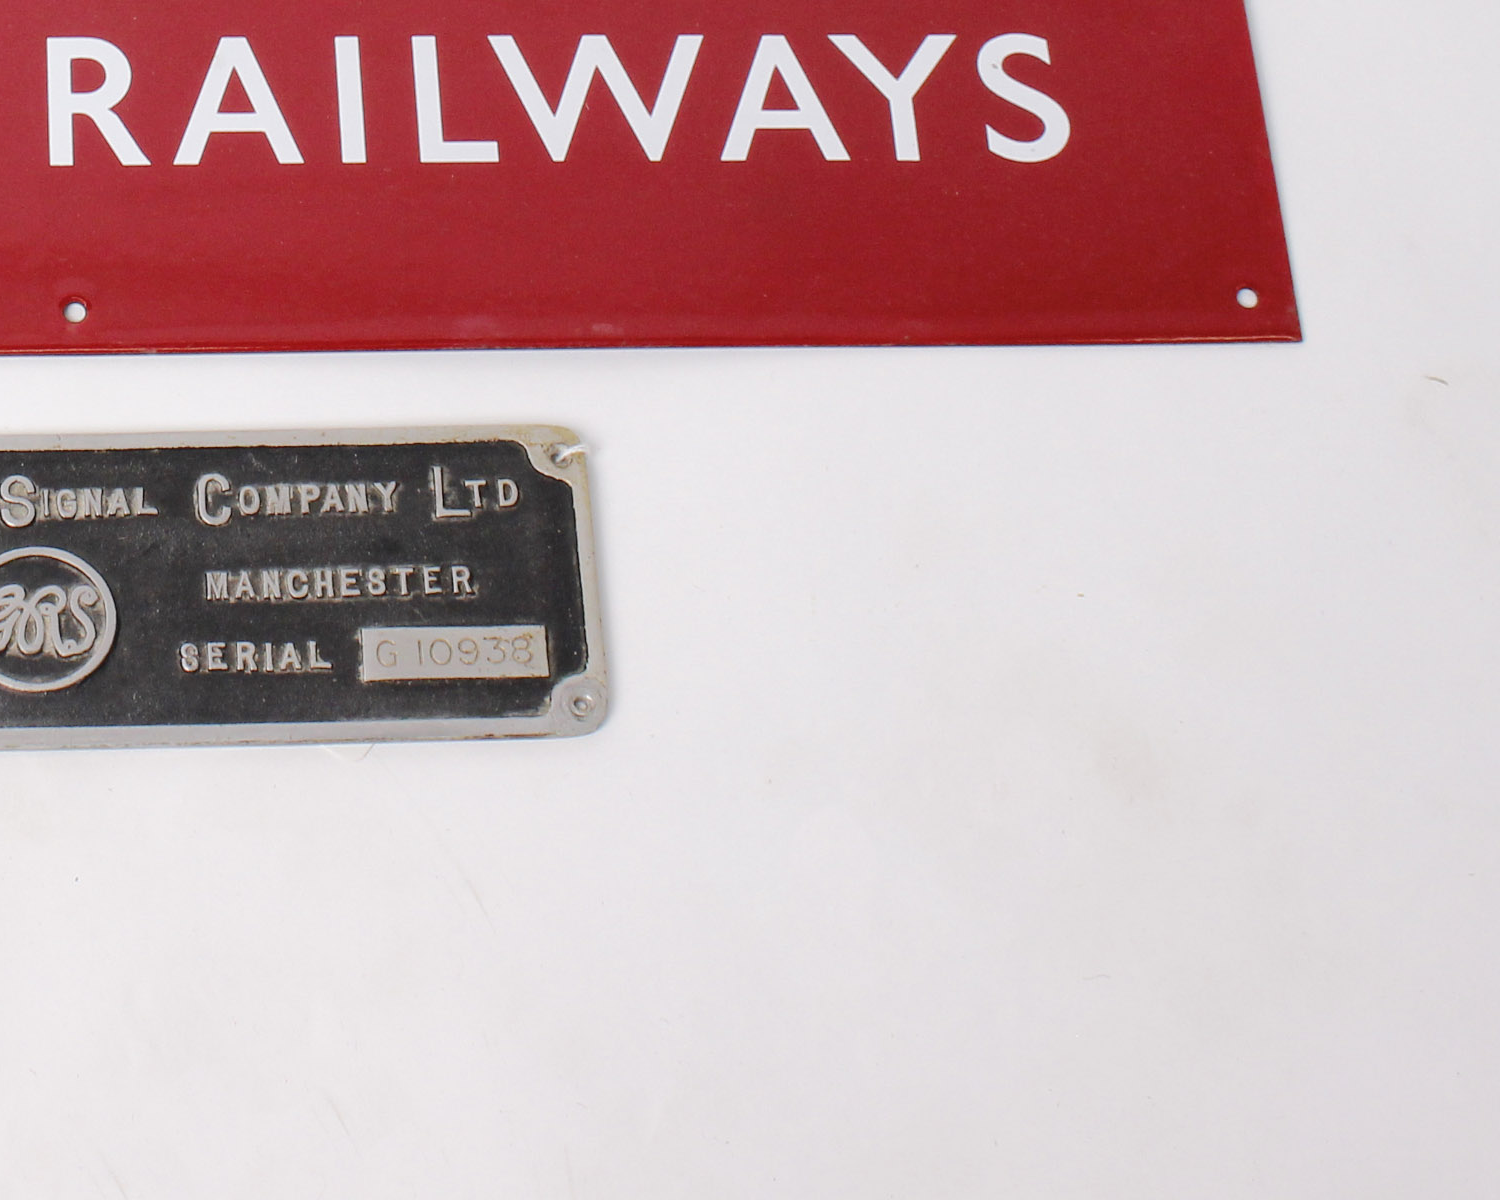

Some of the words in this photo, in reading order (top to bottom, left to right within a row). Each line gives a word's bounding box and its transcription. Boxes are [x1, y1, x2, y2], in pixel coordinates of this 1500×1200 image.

[46, 34, 1071, 167] RAILWAYS
[203, 564, 476, 600] MANCHESTER
[179, 640, 334, 674] SERIAL
